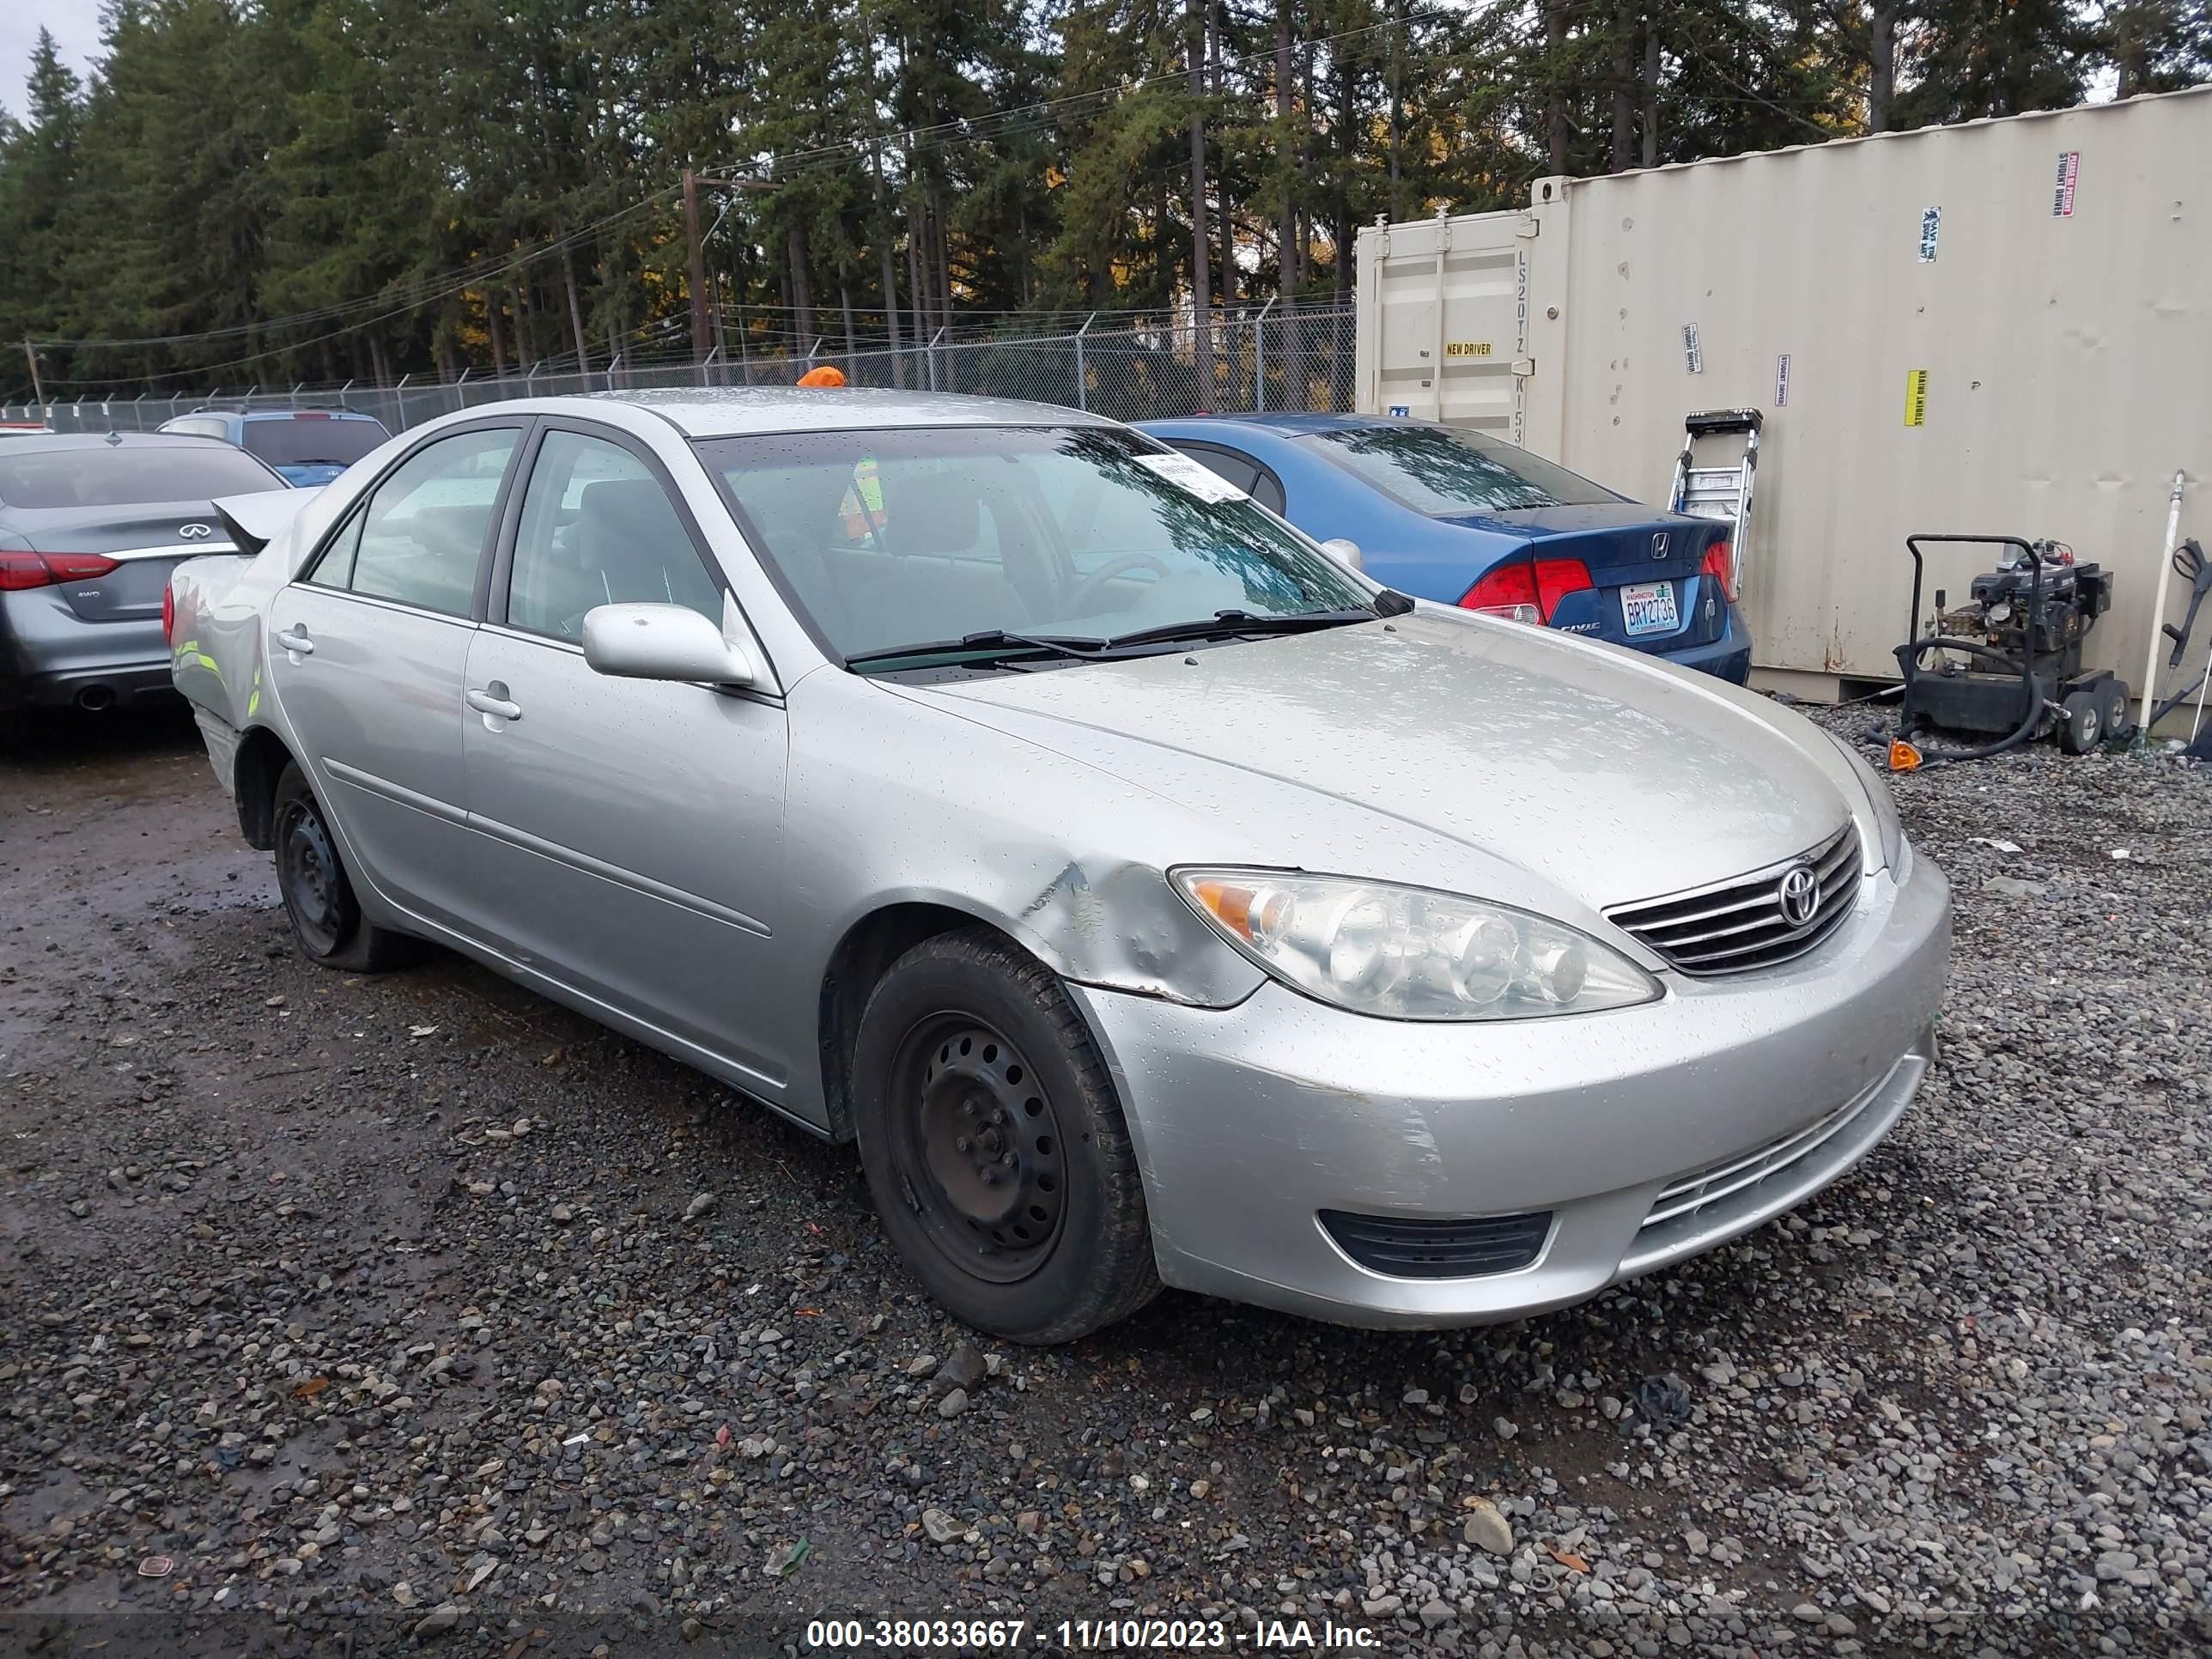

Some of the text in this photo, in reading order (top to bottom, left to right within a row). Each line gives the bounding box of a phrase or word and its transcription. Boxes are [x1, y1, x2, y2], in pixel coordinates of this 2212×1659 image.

[2053, 154, 2069, 216] STUDENT DRIVER
[1447, 343, 1492, 356] NEW DRIVER
[1684, 325, 1696, 373] STUDENT DRIVER
[1778, 384, 1786, 404] DRIVER
[1914, 370, 1927, 426] STUDENT DRIVER
[1626, 591, 1655, 601] WASHINGTON
[1627, 598, 1675, 626] BRY2736
